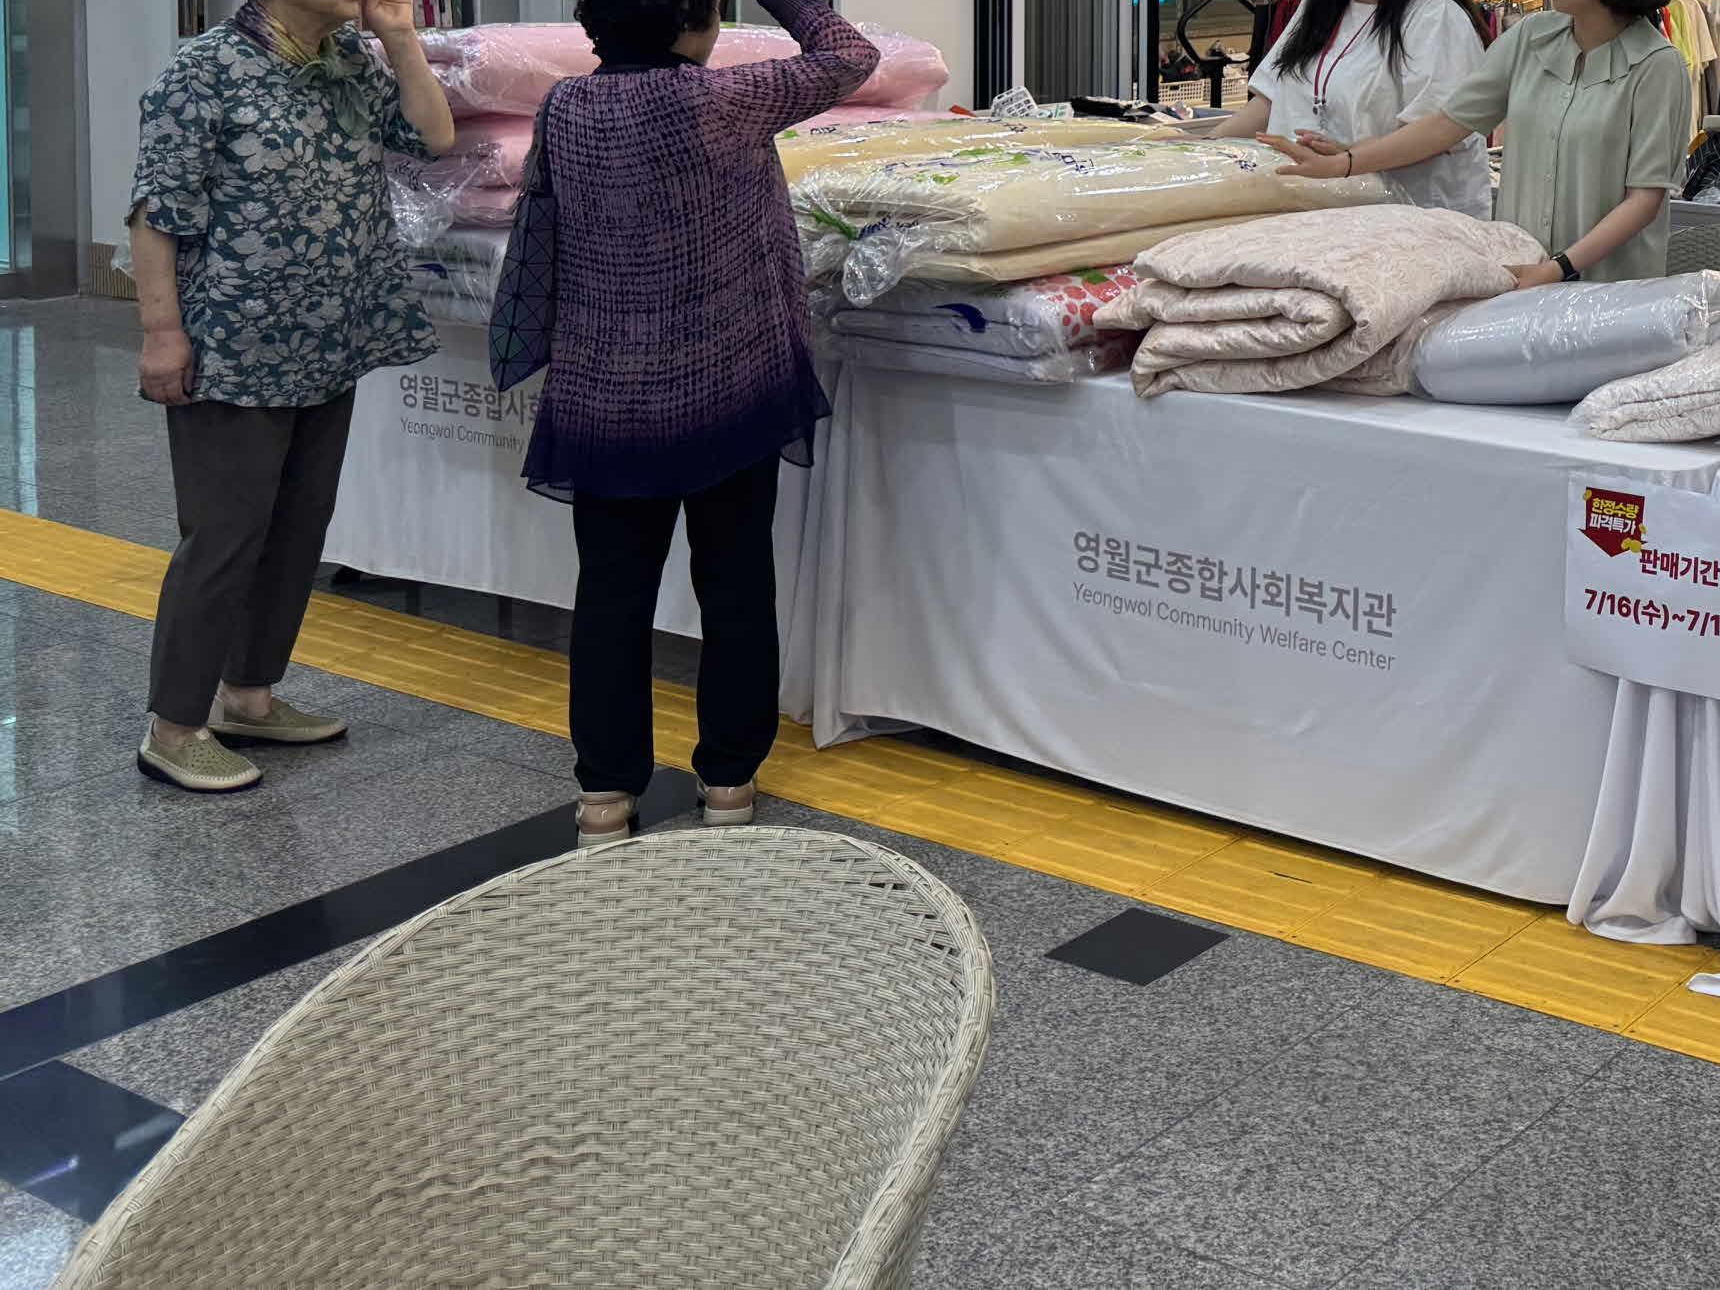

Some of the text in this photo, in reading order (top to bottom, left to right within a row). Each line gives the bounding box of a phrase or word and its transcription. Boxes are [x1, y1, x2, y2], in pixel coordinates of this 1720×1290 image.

[400, 417, 525, 454] Yeongwol Community
[1589, 513, 1637, 535] 파격특가
[1591, 497, 1641, 519] 한정수량
[1073, 530, 1398, 639] 영월군종합사회복지관
[1073, 581, 1397, 671] Yeongwol Community Welfare Center
